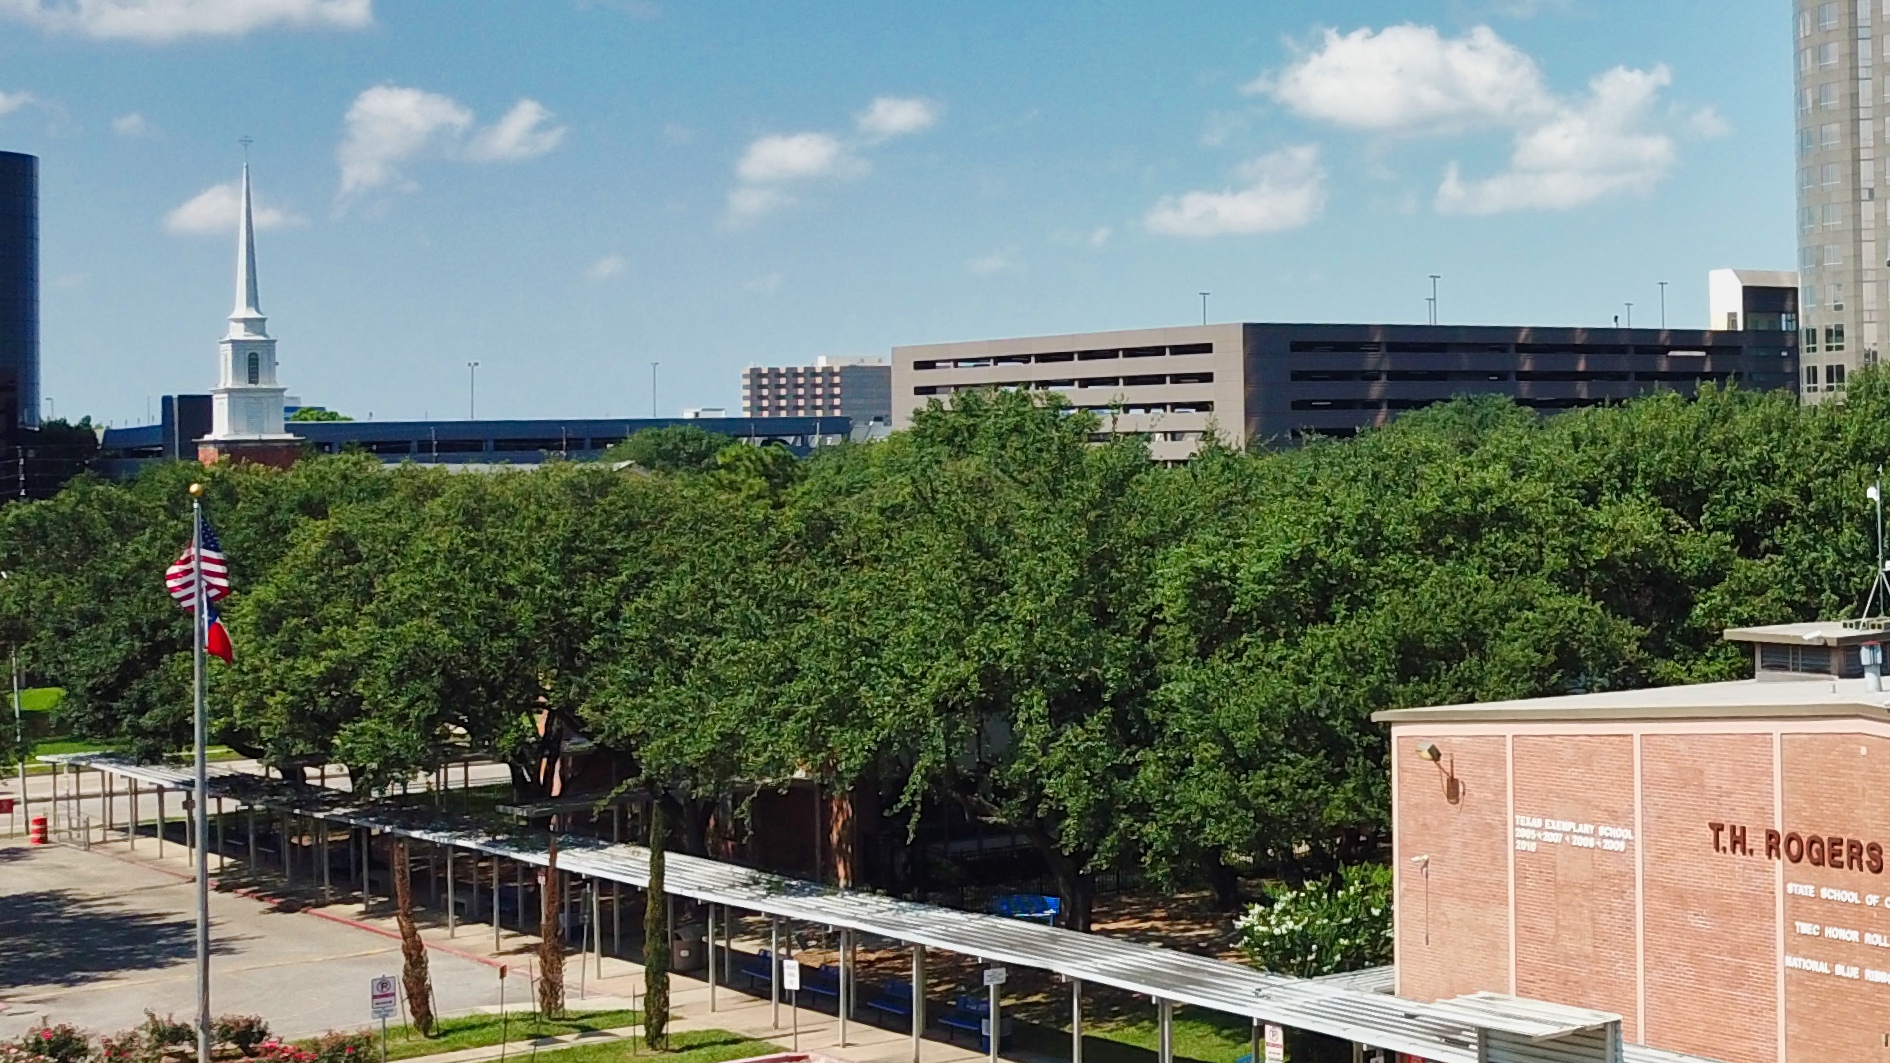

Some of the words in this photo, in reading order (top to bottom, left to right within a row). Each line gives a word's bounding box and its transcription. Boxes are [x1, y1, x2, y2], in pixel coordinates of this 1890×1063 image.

[1515, 815, 1542, 828] TEXAS
[1545, 819, 1595, 834] EXEMPLARY
[1598, 826, 1634, 840] SCHOOL
[1764, 828, 1884, 875] ROGERS
[1786, 882, 1816, 898] STATE
[1820, 887, 1861, 904] SCHOOL
[1865, 893, 1880, 907] OF
[1824, 926, 1860, 943] HONOR
[1864, 933, 1890, 948] ROLL
[1785, 955, 1831, 974] NATIONAL
[1834, 963, 1860, 979] BLUE
